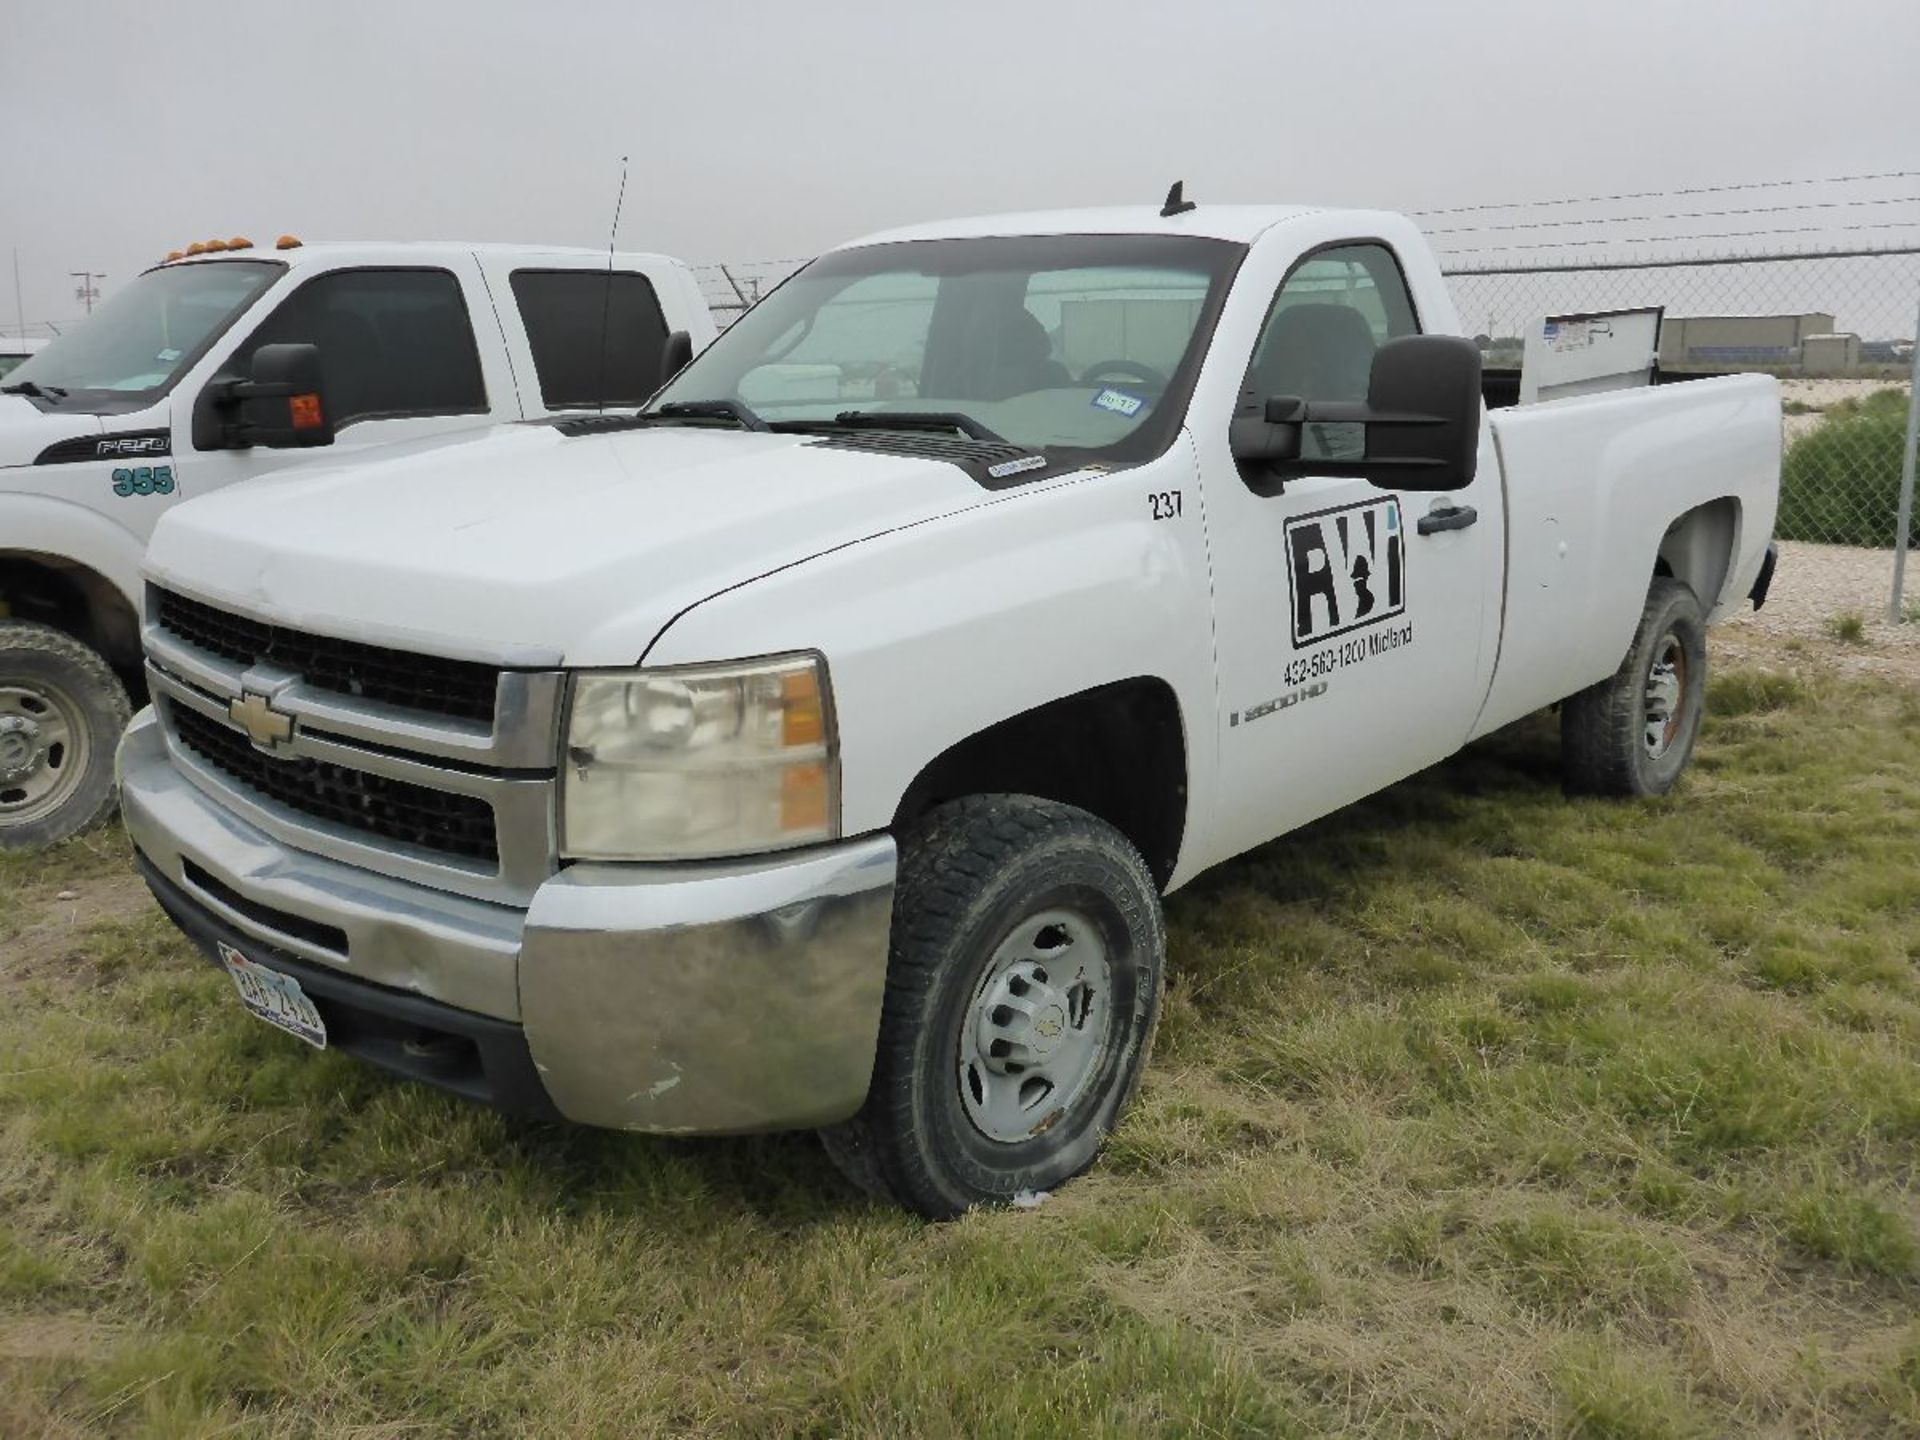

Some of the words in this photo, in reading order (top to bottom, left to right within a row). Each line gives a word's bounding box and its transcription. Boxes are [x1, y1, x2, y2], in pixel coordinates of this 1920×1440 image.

[112, 465, 175, 497] 355
[1149, 490, 1182, 520] 237
[1369, 621, 1412, 657] Midland
[1301, 681, 1329, 701] HD
